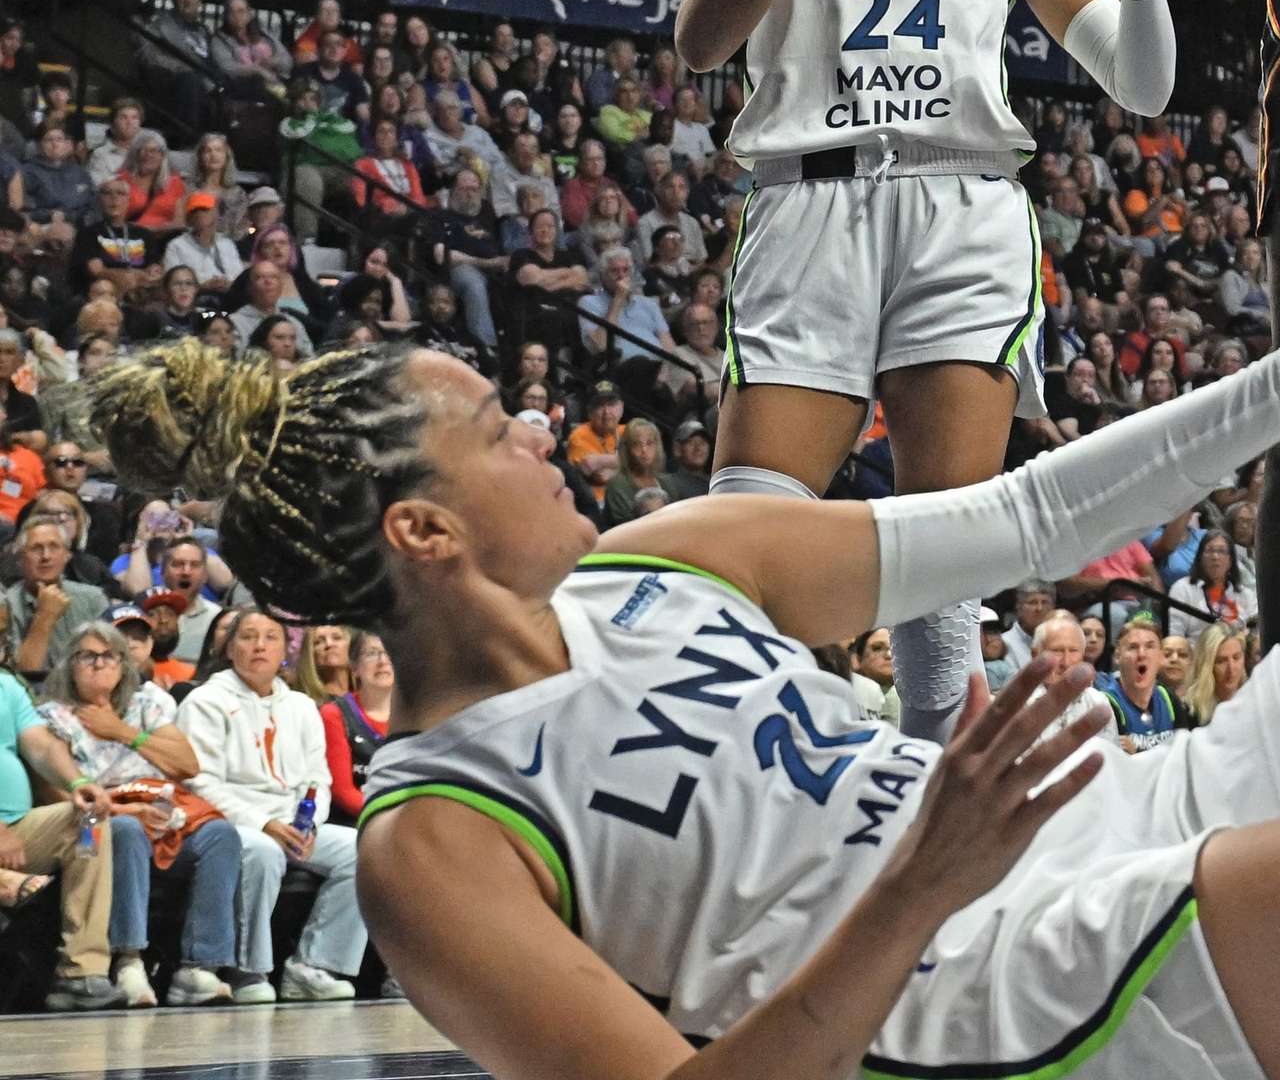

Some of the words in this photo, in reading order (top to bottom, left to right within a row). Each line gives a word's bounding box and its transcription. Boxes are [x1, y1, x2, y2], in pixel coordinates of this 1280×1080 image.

[837, 64, 942, 95] MAYO
[825, 98, 951, 129] CLINIC
[588, 607, 797, 840] LYNX
